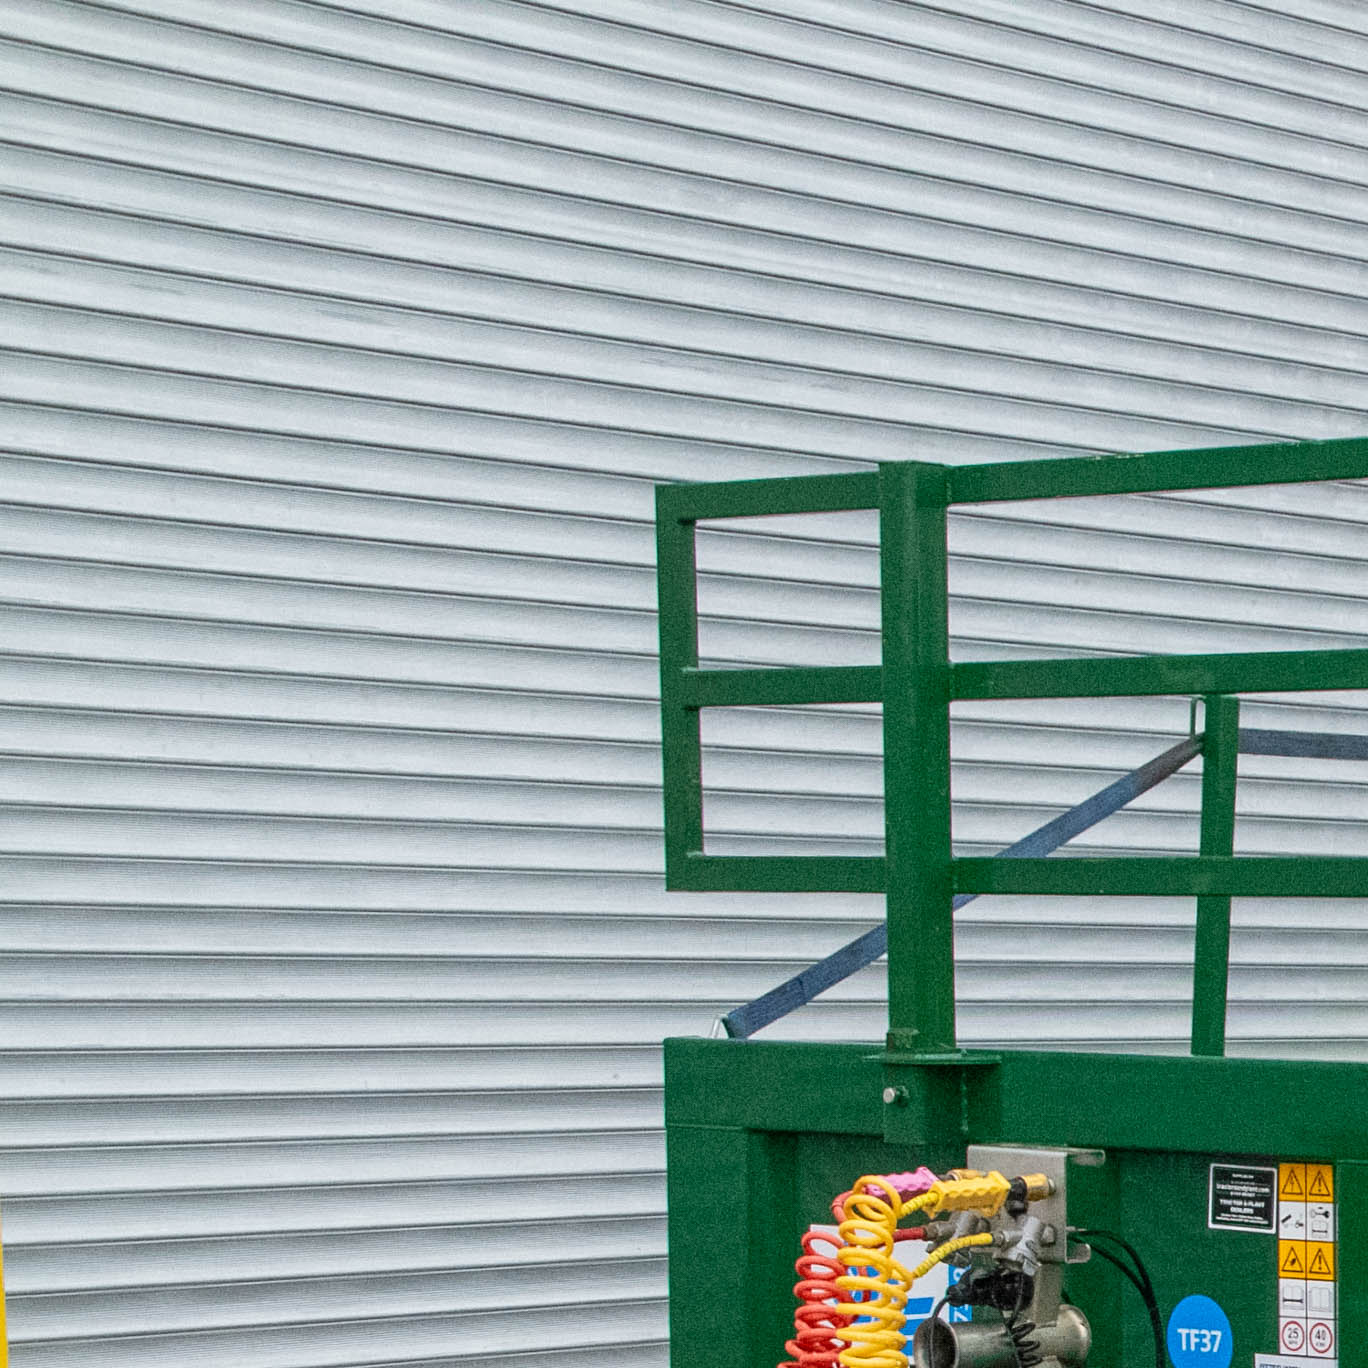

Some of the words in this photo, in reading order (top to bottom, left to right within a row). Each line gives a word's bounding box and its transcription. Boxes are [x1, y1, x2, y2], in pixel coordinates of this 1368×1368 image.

[1287, 1327, 1299, 1339] 25
[1315, 1329, 1327, 1341] 40
[1177, 1328, 1222, 1353] TF37
